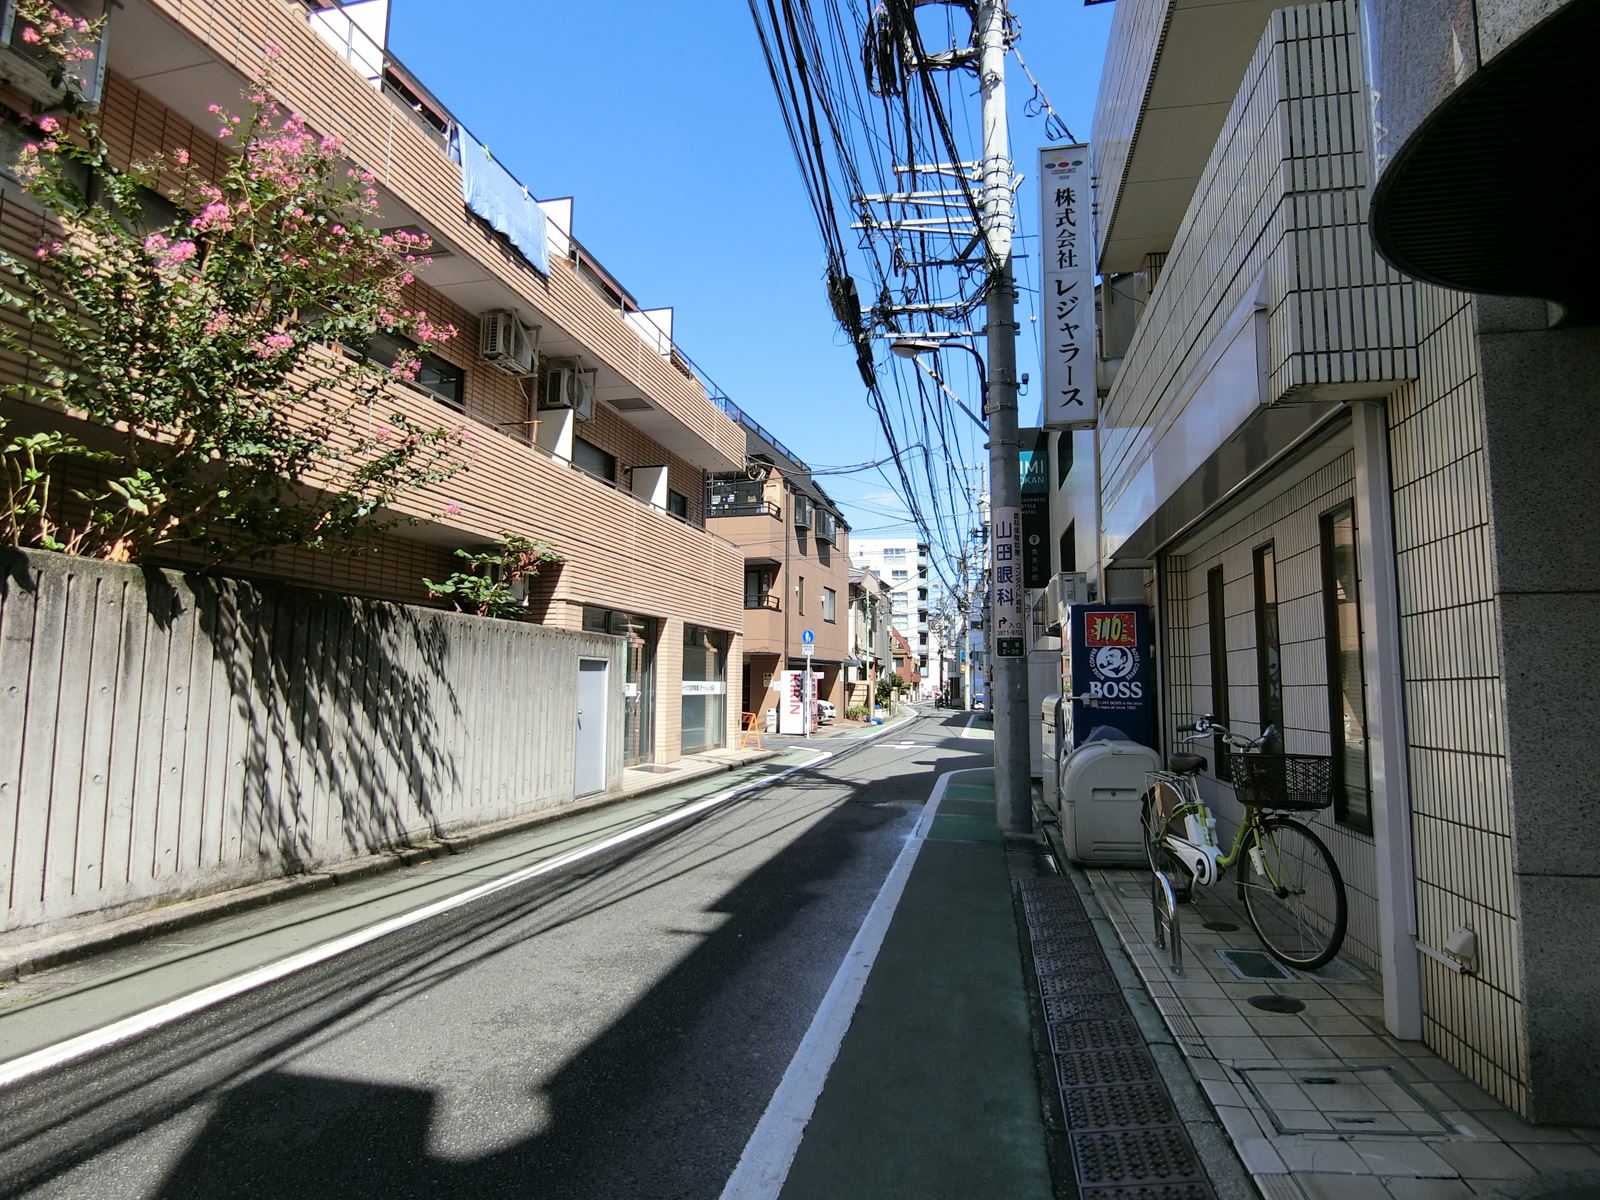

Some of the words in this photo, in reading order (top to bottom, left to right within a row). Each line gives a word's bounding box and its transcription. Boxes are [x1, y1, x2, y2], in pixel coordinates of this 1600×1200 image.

[996, 521, 1014, 606] 山田眼科
[1089, 647, 1098, 668] COFFEE
[1130, 647, 1140, 662] BOSS
[1092, 667, 1105, 680] BOSS
[1125, 662, 1140, 681] COFFEE
[789, 673, 801, 715] KIRIN
[1089, 681, 1143, 699] BOSS
